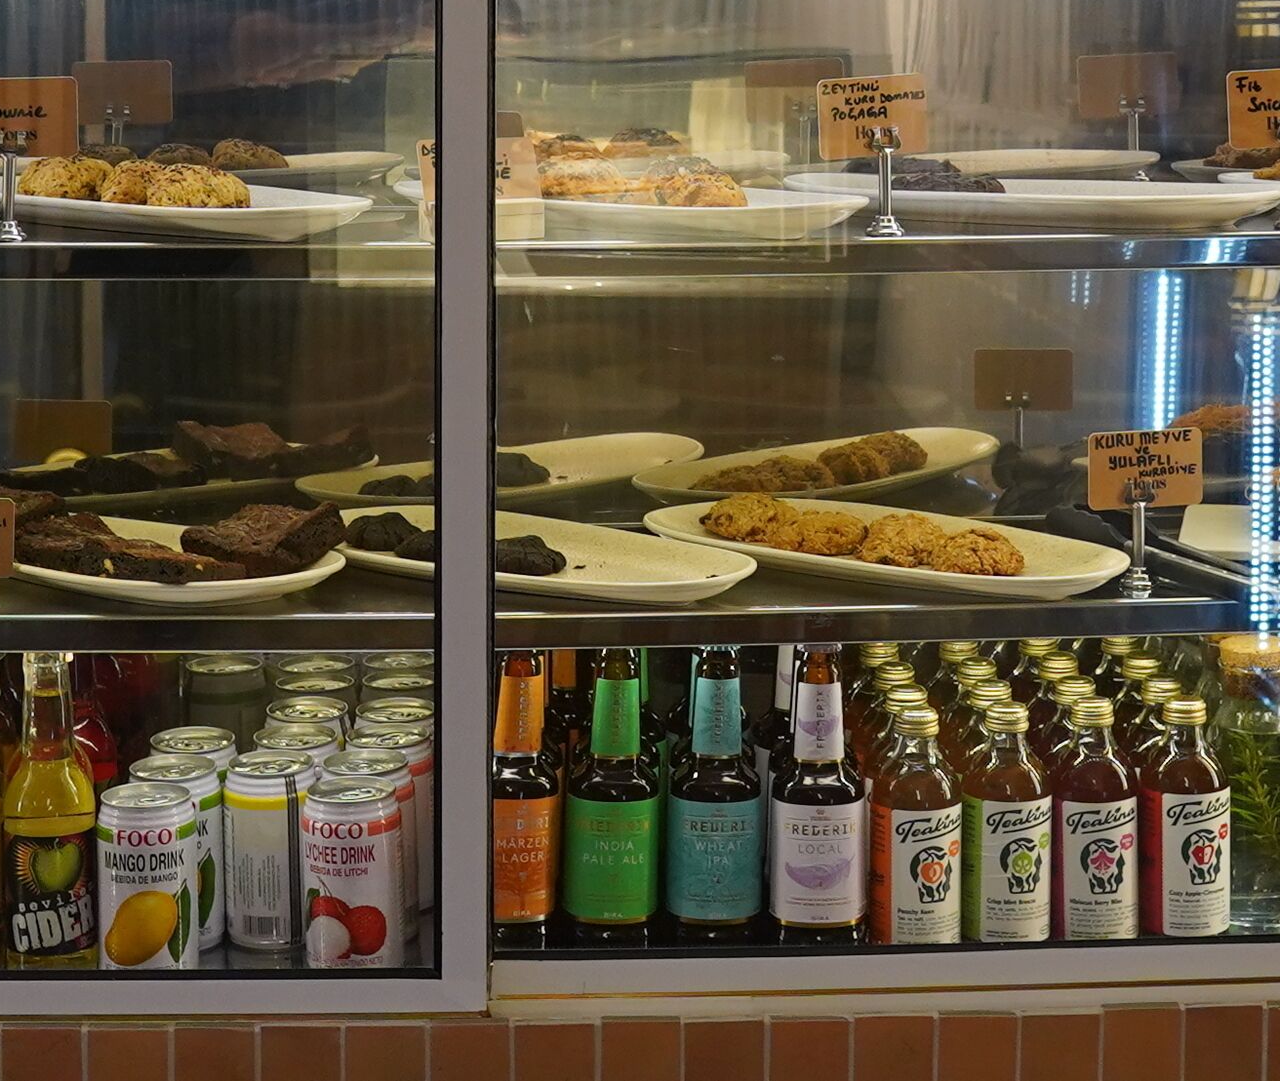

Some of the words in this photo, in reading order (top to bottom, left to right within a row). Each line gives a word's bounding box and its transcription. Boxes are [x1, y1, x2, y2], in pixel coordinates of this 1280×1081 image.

[1094, 433, 1135, 450] KURU
[1139, 429, 1192, 446] MEYVE
[1134, 445, 1150, 455] ve
[311, 820, 364, 840] FOCO
[784, 822, 856, 836] FREDERIK
[116, 828, 174, 848] FOCO
[595, 840, 635, 851] INDIA
[694, 840, 743, 852] WHEAT
[798, 843, 843, 855] LOCAL
[305, 841, 338, 865] LYCHEE
[340, 844, 376, 865] DRINK
[502, 851, 546, 864] LAGER
[583, 854, 615, 865] PALE
[622, 853, 645, 865] ALE
[104, 851, 146, 873] MANGO
[149, 848, 186, 871] DRINK
[707, 856, 729, 869] IPA
[332, 868, 343, 877] DE
[344, 866, 369, 877] LITCHI
[138, 875, 149, 885] DE
[150, 872, 179, 884] MANGO
[11, 893, 95, 953] CIDER
